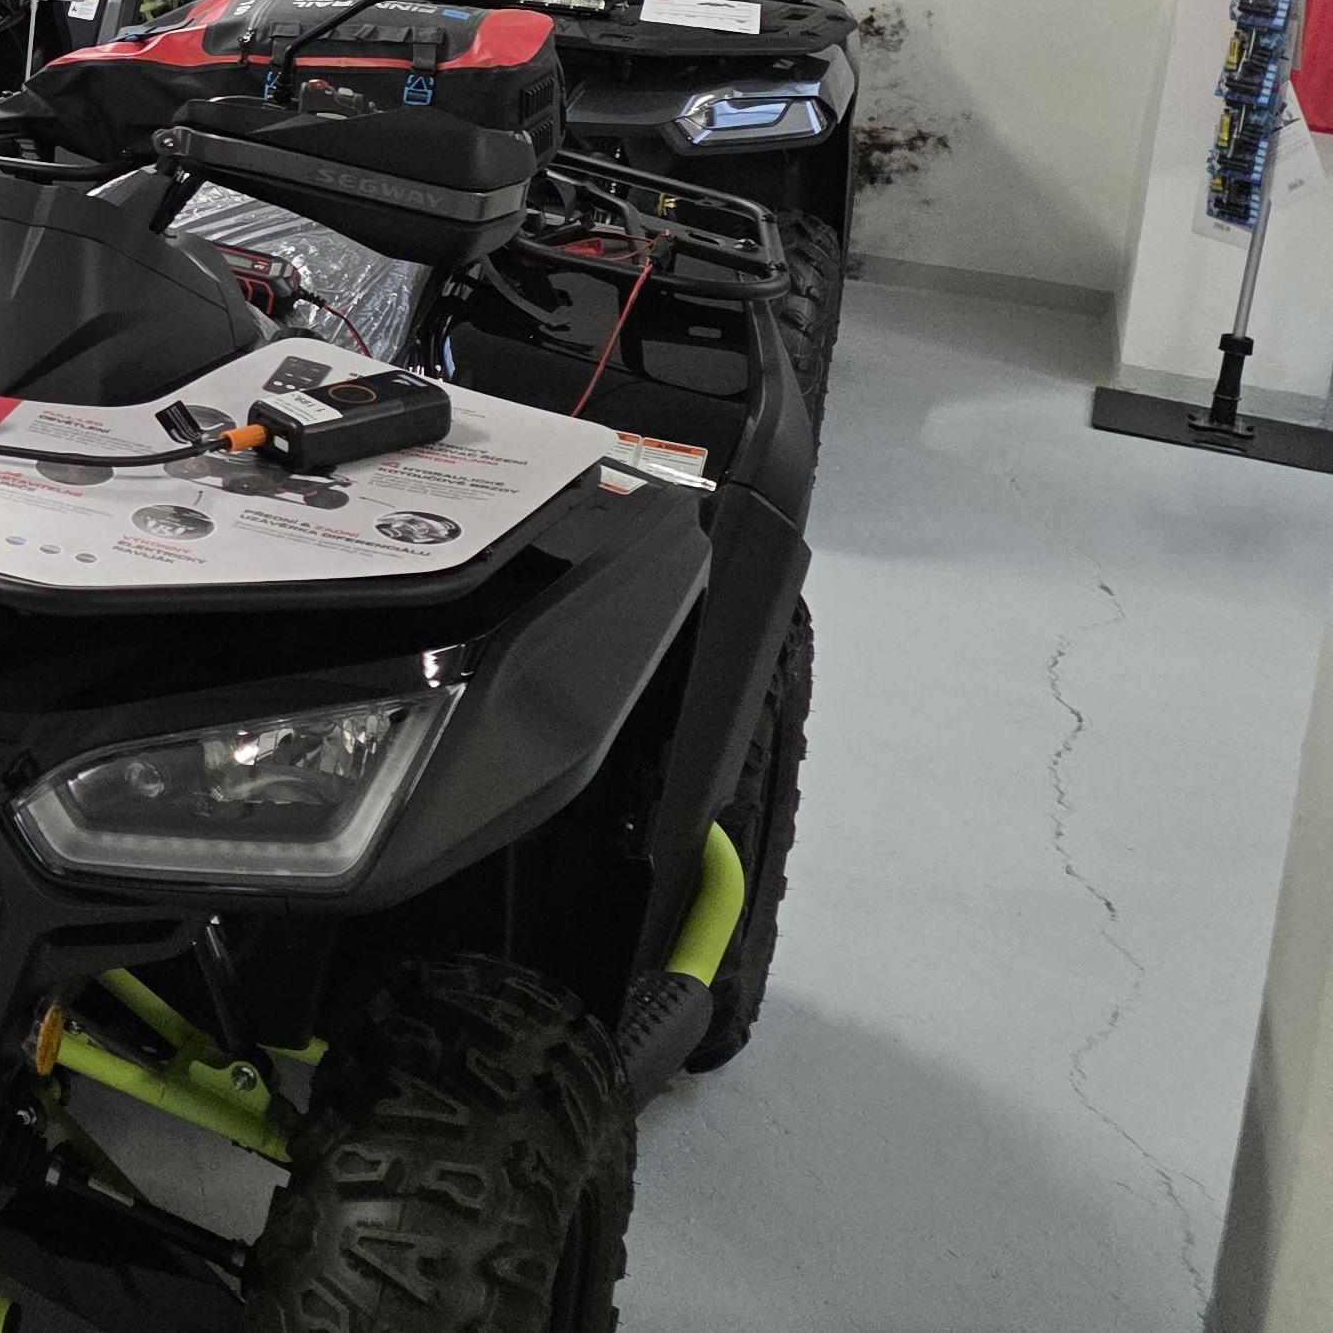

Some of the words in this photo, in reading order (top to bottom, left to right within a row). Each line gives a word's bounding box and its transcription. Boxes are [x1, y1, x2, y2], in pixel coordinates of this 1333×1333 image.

[316, 168, 445, 209] SEGWAY
[243, 509, 299, 524] PŘEDNÍ
[320, 532, 431, 556] DIFERENCIÁLU
